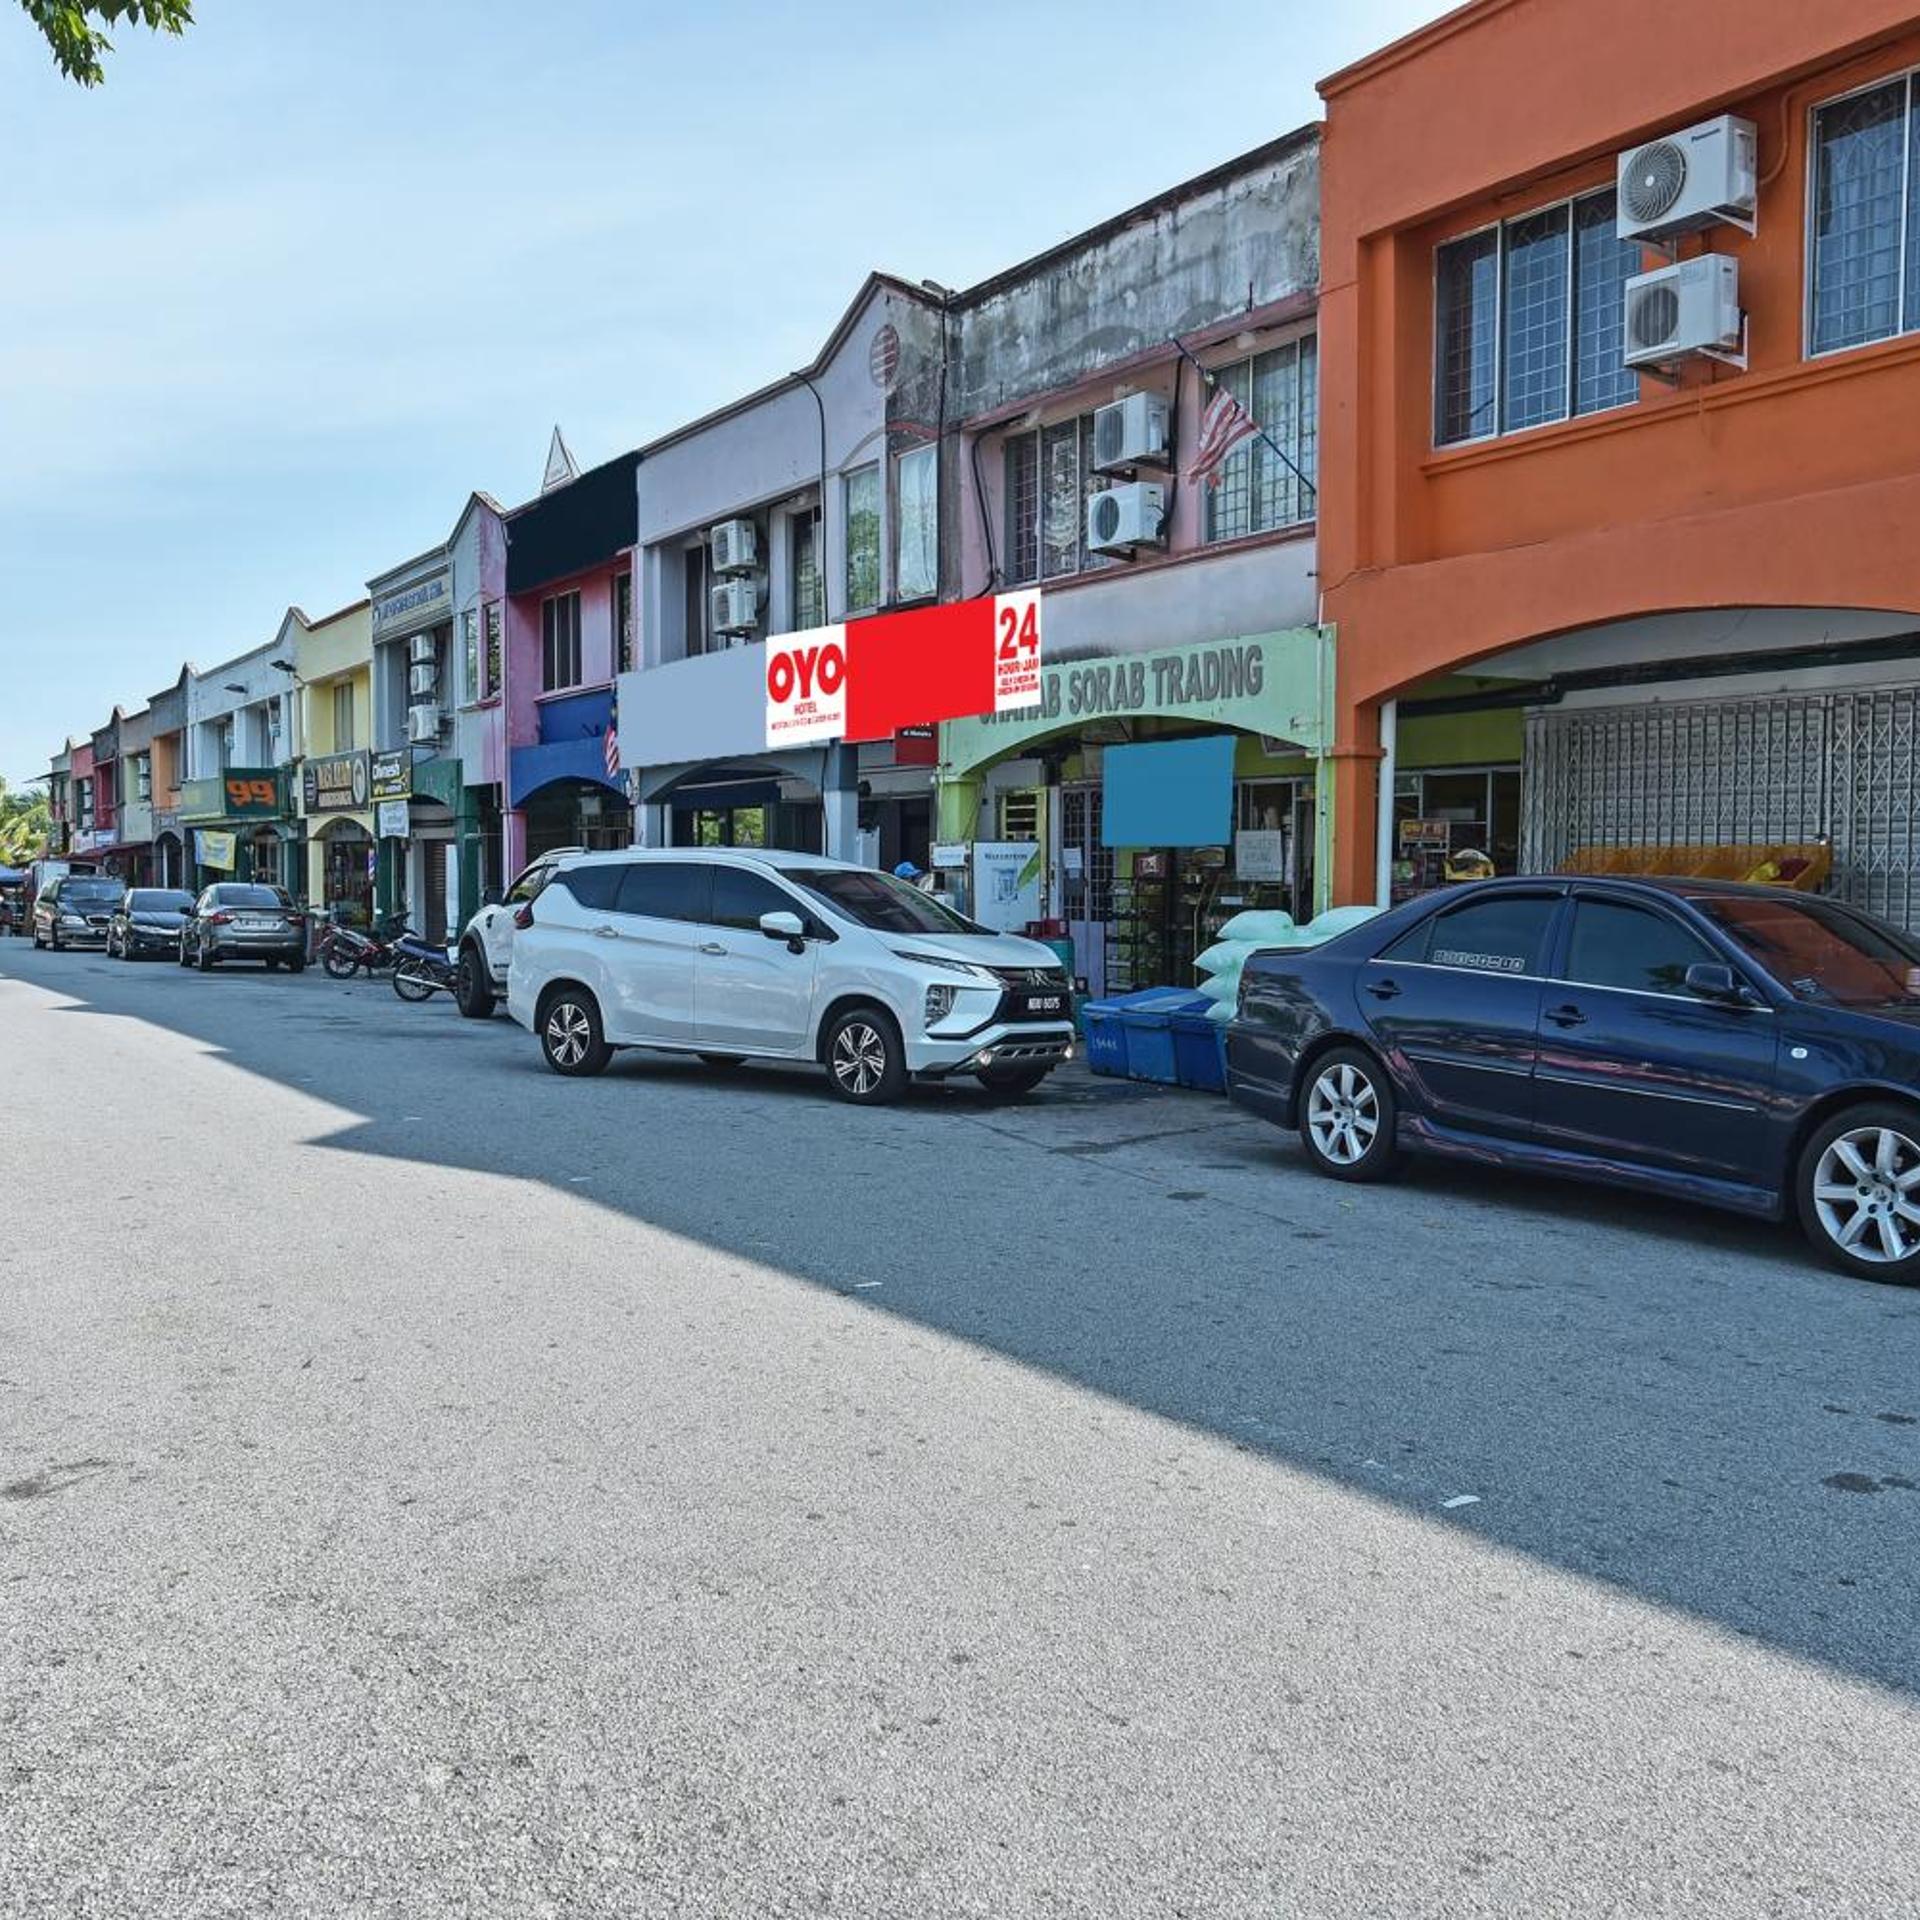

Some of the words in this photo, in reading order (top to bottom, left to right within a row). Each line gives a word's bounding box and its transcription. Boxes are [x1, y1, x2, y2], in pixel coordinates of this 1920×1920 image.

[999, 602, 1038, 660] 24
[767, 643, 844, 703] OYO
[1069, 661, 1145, 716] SORAB
[1151, 645, 1263, 706] TRADING
[794, 701, 817, 715] HOTEL
[226, 778, 277, 806] 99
